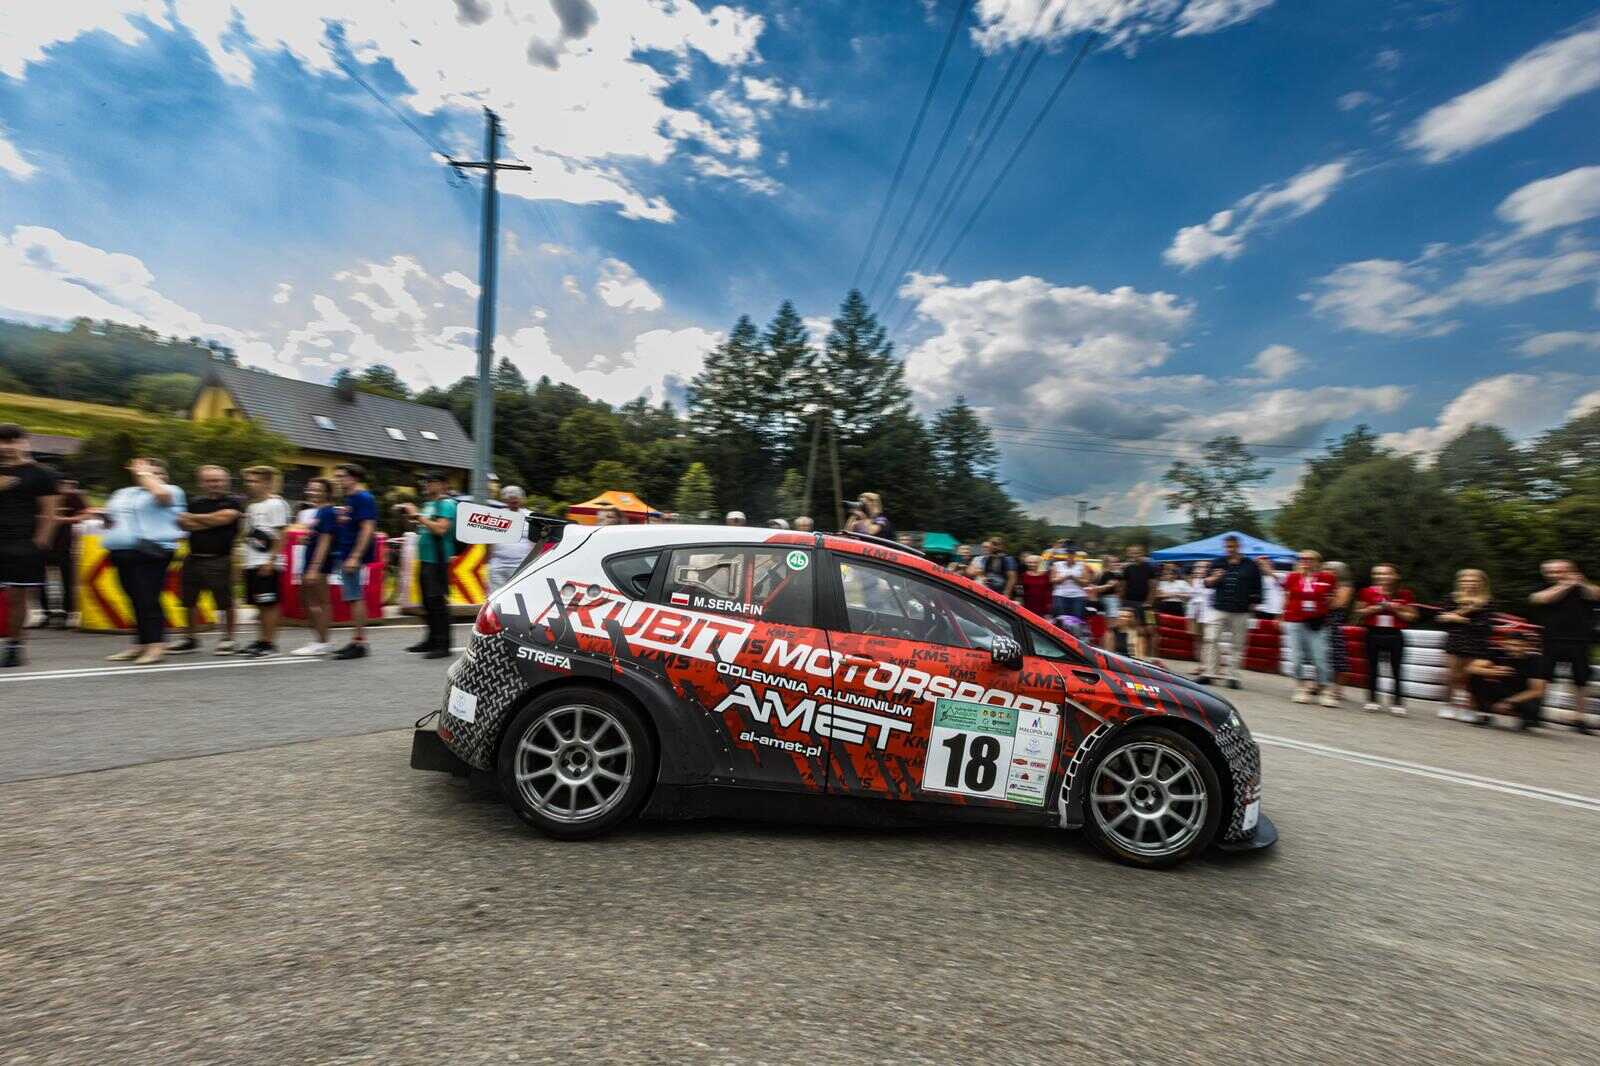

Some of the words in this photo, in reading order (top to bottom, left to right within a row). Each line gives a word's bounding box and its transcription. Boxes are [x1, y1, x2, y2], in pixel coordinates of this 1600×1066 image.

[470, 513, 509, 528] KUBIT
[693, 596, 763, 616] M.SERAFIN
[566, 591, 746, 656] KUBIT
[516, 646, 572, 670] STREFA
[912, 647, 950, 663] KMS
[716, 661, 809, 694] ODLEWNIA
[814, 686, 913, 717] ALUMINIUM
[713, 684, 913, 750] AMET
[739, 730, 822, 758] al-amet.pl
[942, 732, 1001, 792] 18
